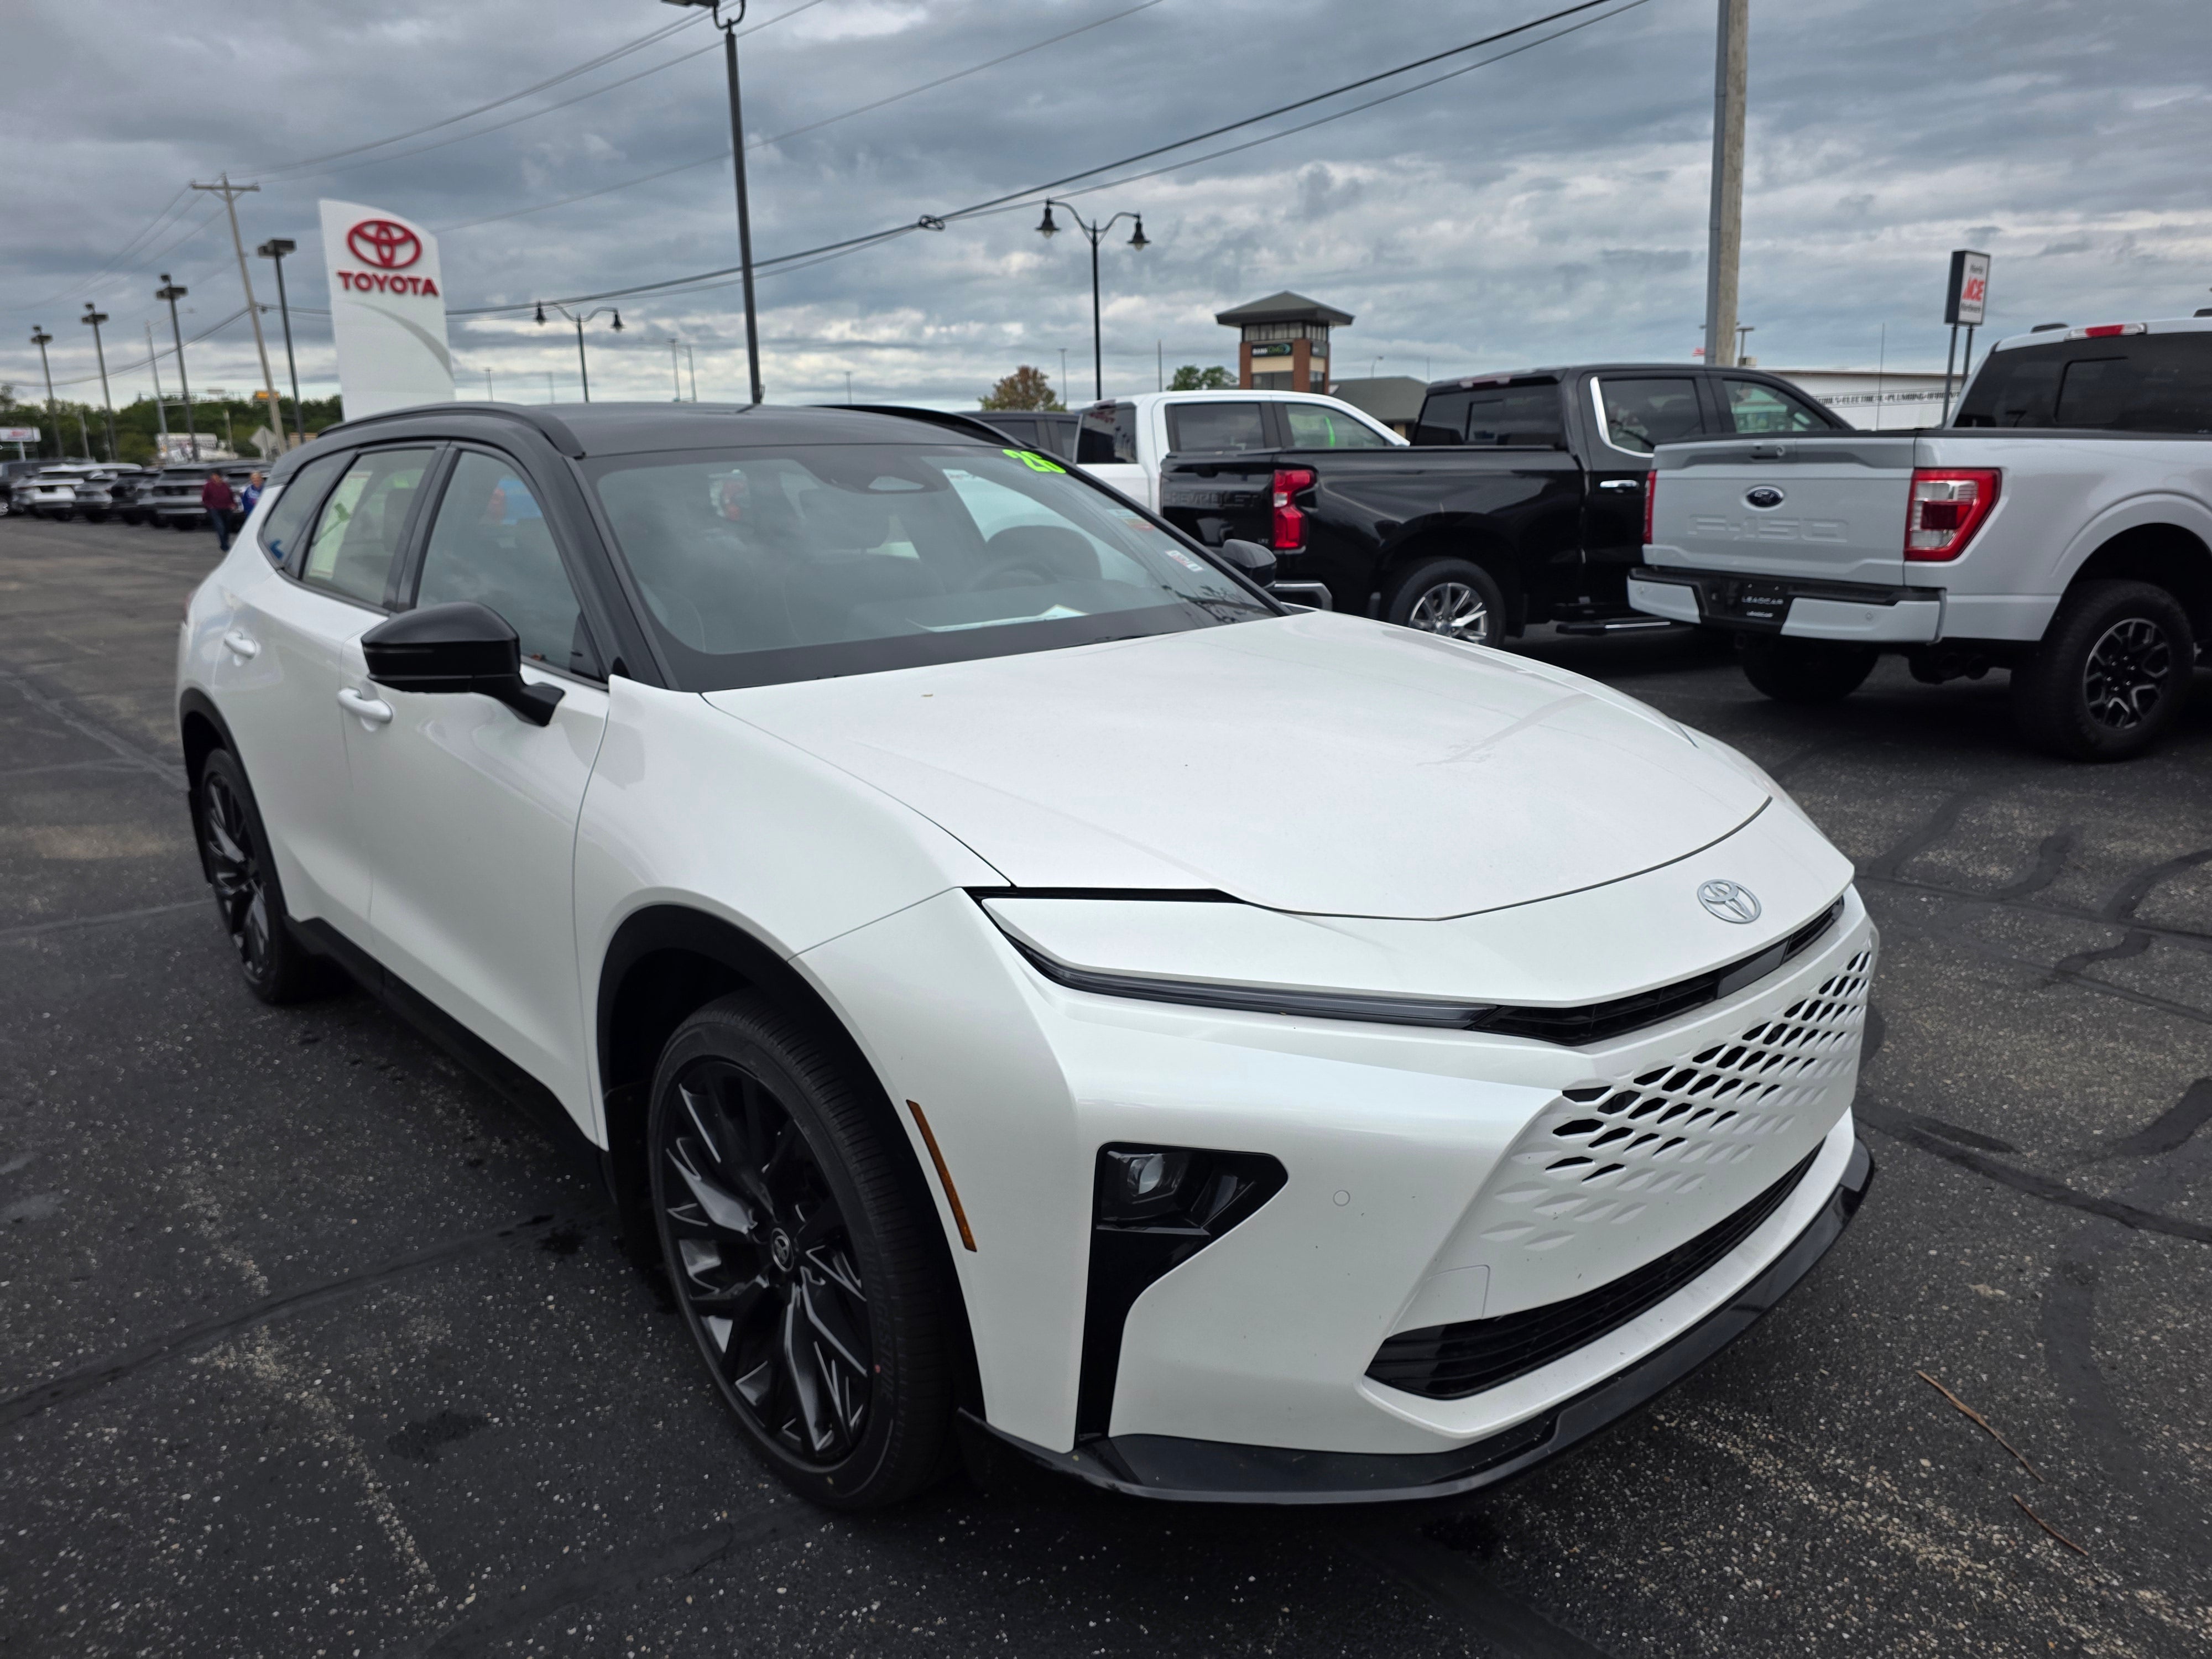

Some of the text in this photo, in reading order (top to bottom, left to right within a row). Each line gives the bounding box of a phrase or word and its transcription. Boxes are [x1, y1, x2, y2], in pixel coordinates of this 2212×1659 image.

[337, 270, 439, 296] TOYOTA
[1961, 276, 1985, 301] ACE
[1687, 514, 1848, 543] F-150
